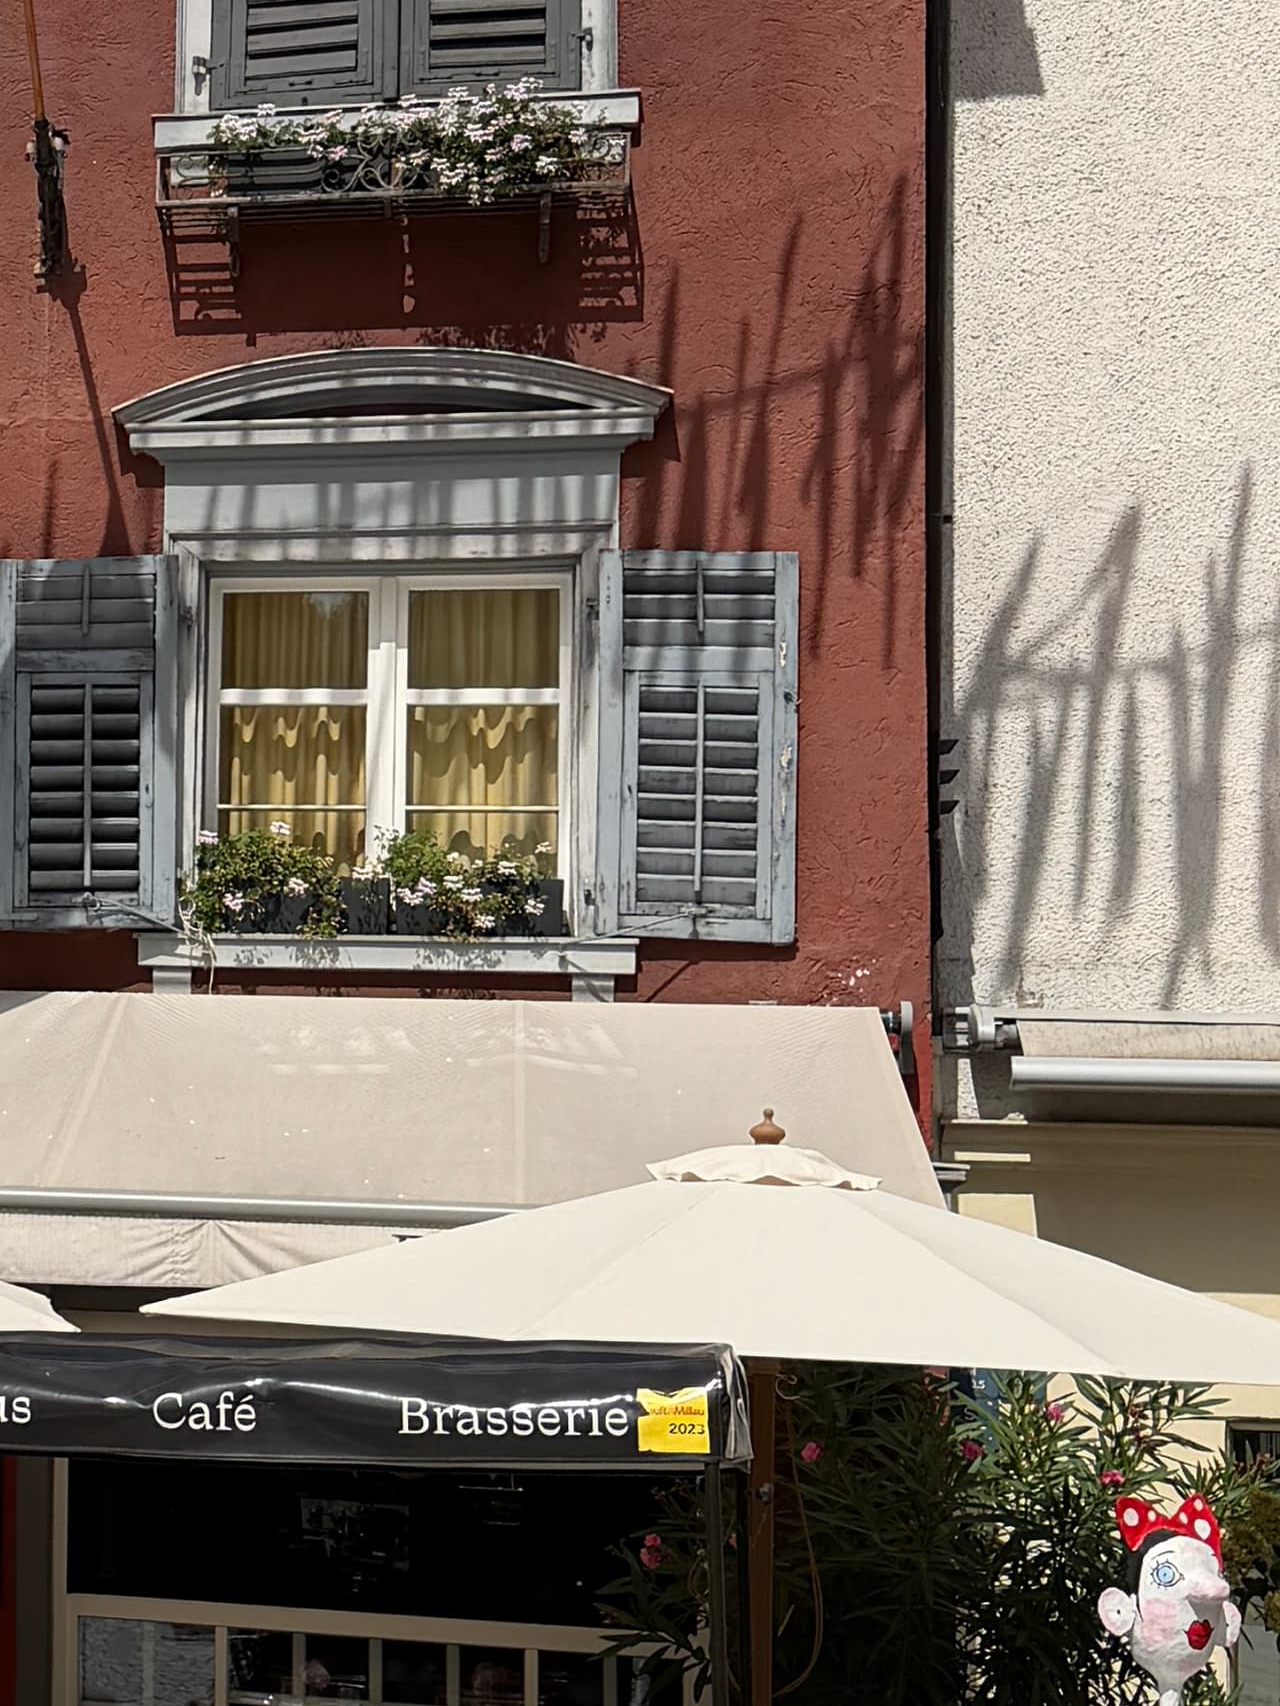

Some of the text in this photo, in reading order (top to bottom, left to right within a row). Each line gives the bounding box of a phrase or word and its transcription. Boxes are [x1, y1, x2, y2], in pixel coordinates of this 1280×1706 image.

[153, 1391, 257, 1432] Café
[398, 1396, 630, 1436] Brasserie
[668, 1423, 706, 1436] 2023
